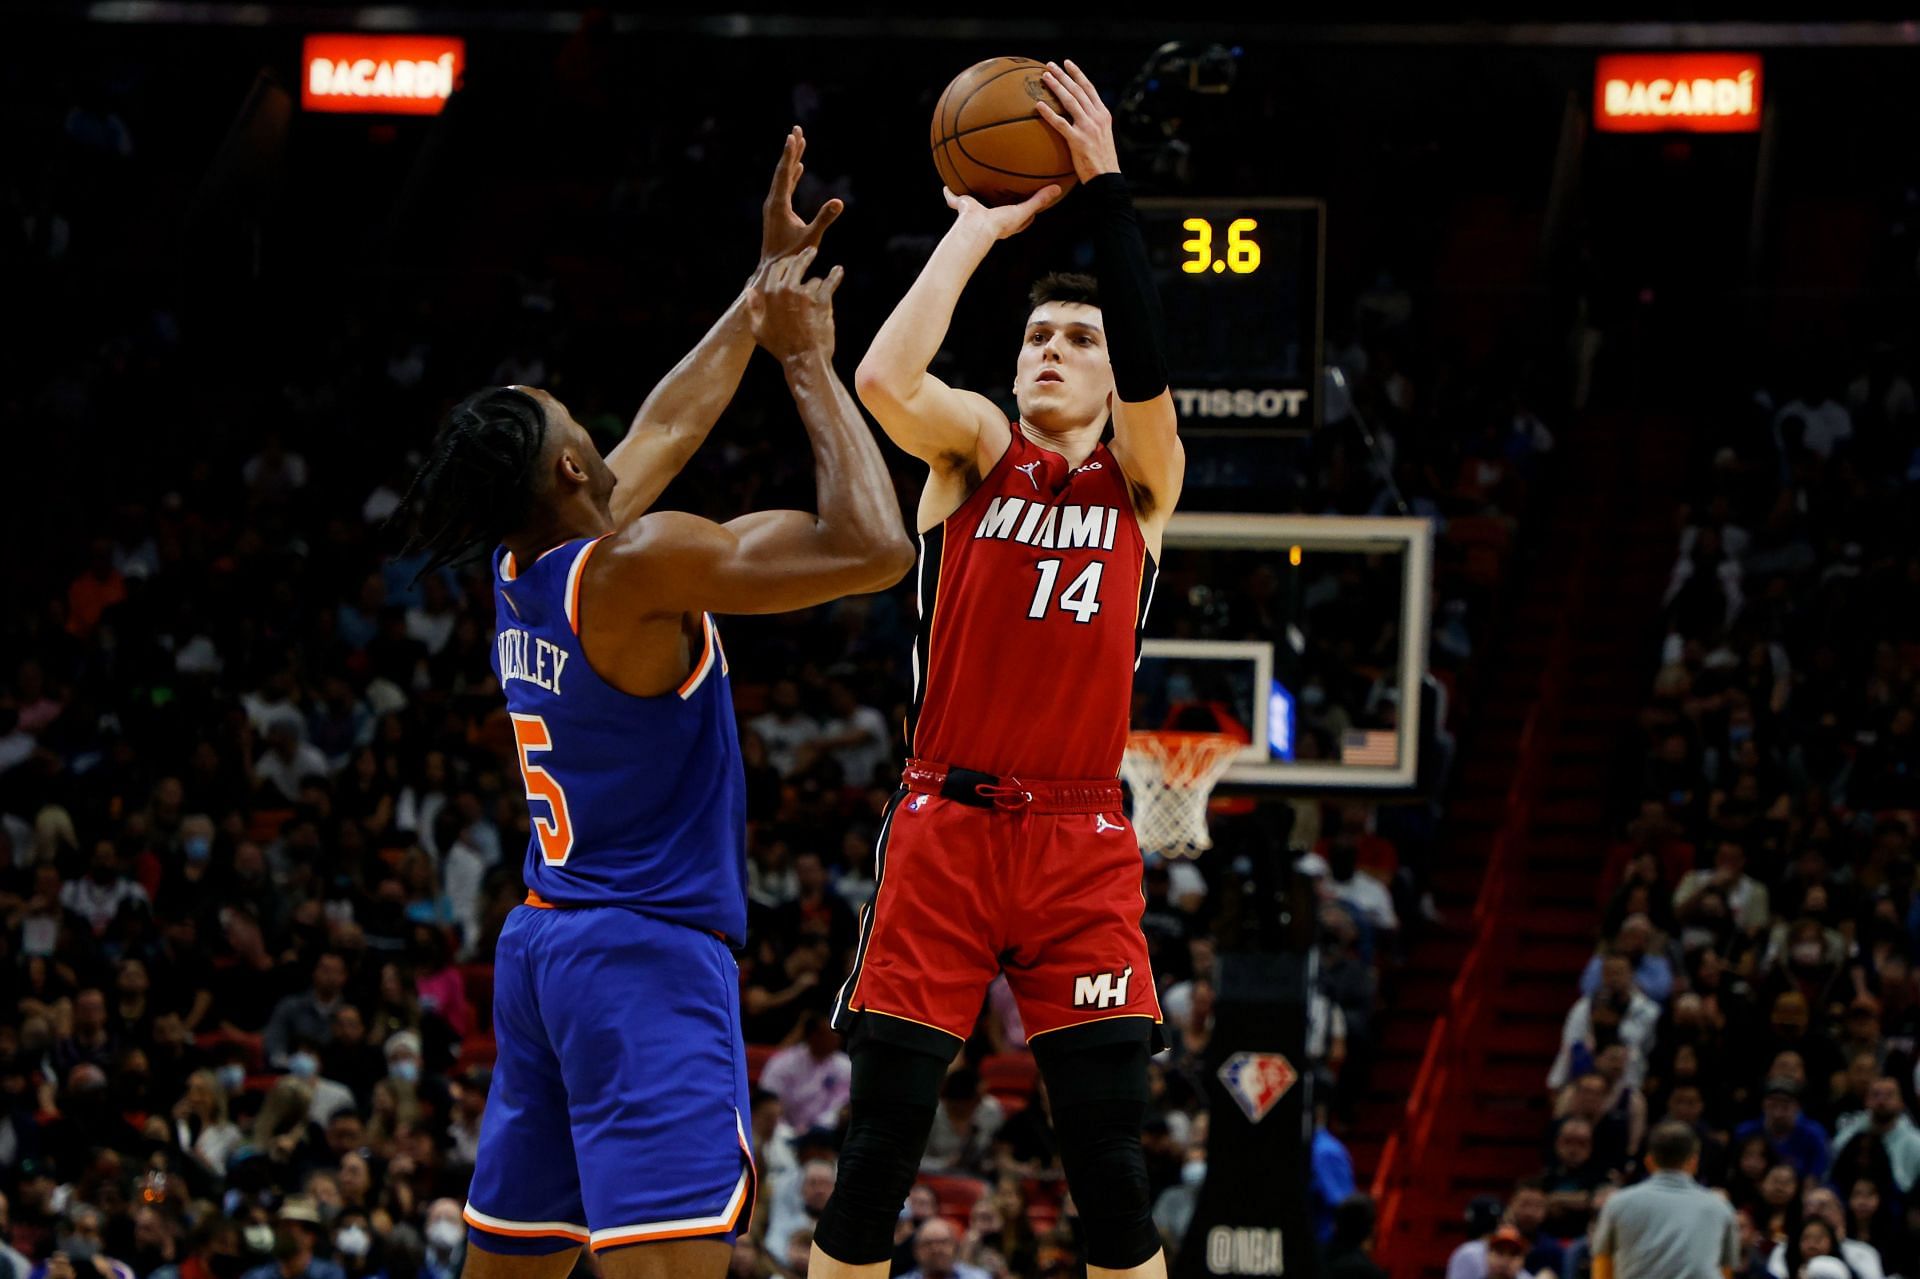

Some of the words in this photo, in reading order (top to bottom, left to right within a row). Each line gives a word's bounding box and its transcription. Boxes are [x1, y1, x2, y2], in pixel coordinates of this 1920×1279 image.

[309, 51, 455, 99] BACARDÍ
[1605, 69, 1755, 116] BACARDÍ
[1182, 218, 1260, 273] 3.6
[1173, 388, 1307, 417] TISSOT
[1075, 461, 1102, 474] KG
[975, 497, 1119, 550] MIAMI
[1028, 559, 1104, 623] 14
[509, 712, 574, 867] 5
